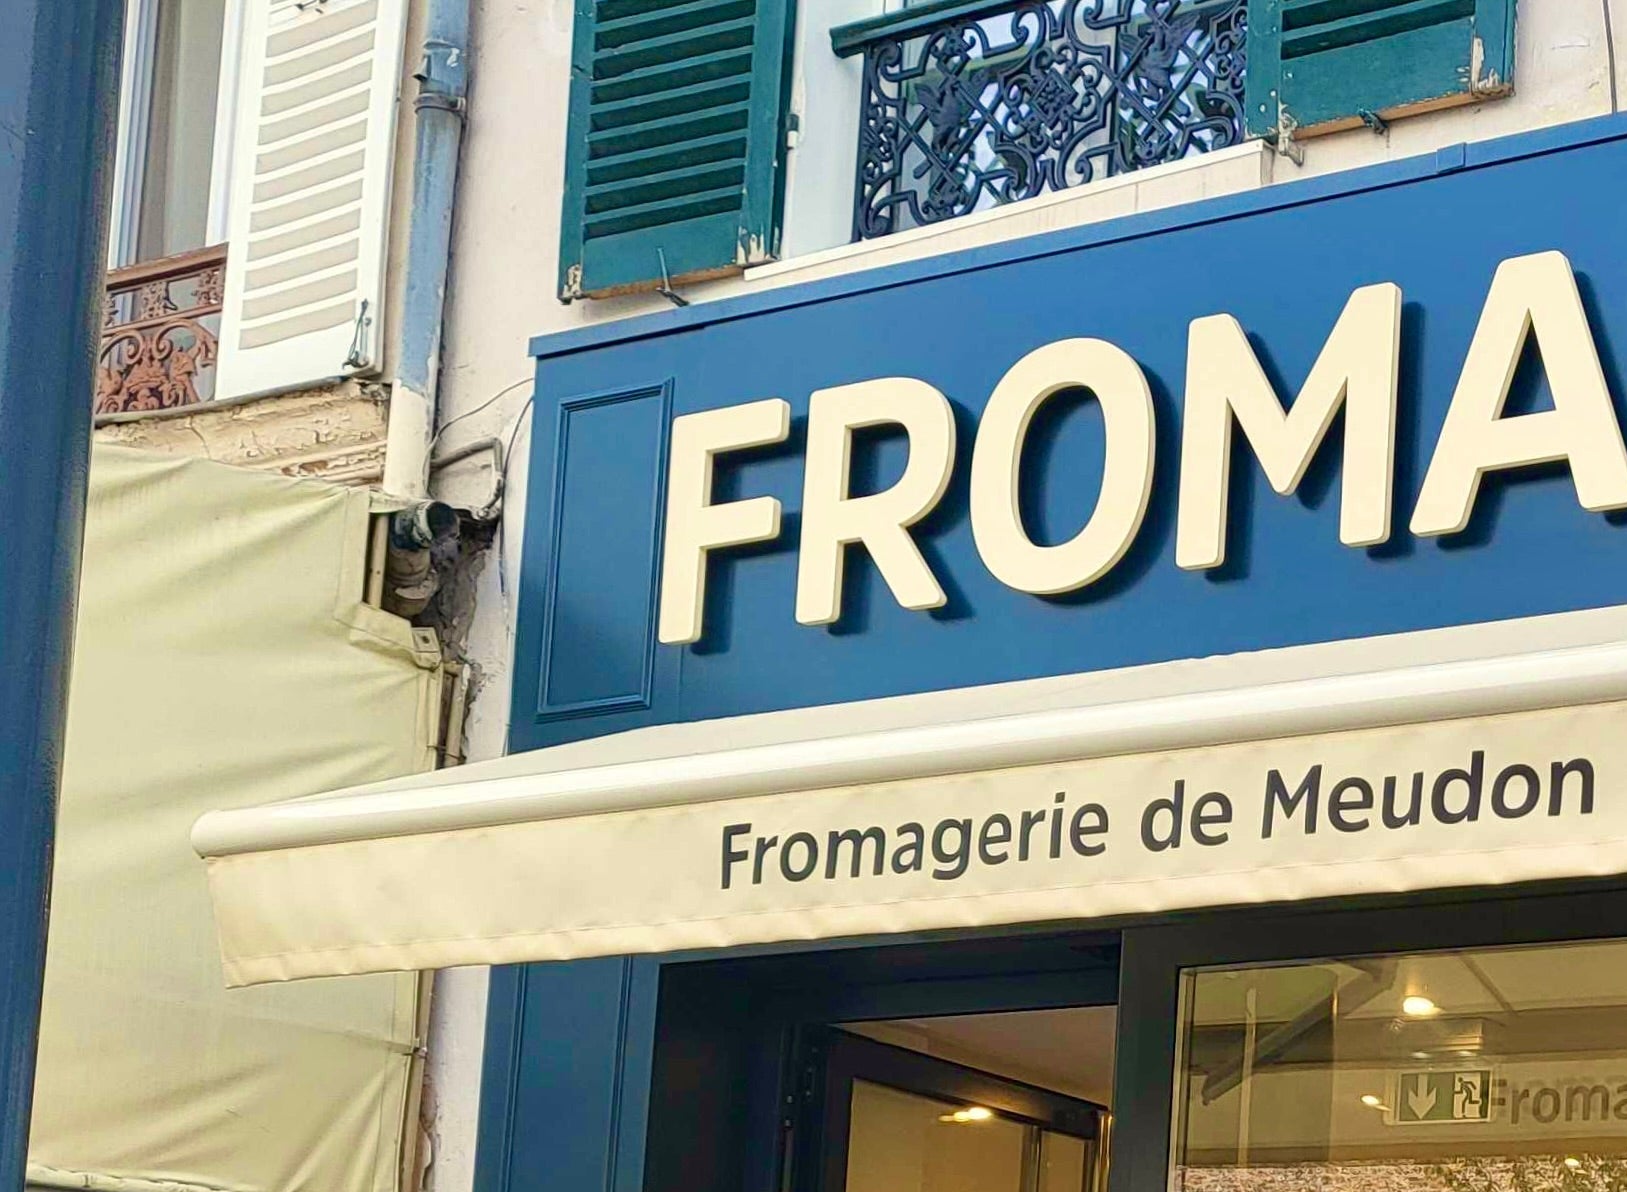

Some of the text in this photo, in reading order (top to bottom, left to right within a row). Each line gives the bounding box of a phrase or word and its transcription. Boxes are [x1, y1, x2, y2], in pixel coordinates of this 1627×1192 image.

[720, 750, 1596, 890] Fromagerie de Meudon
